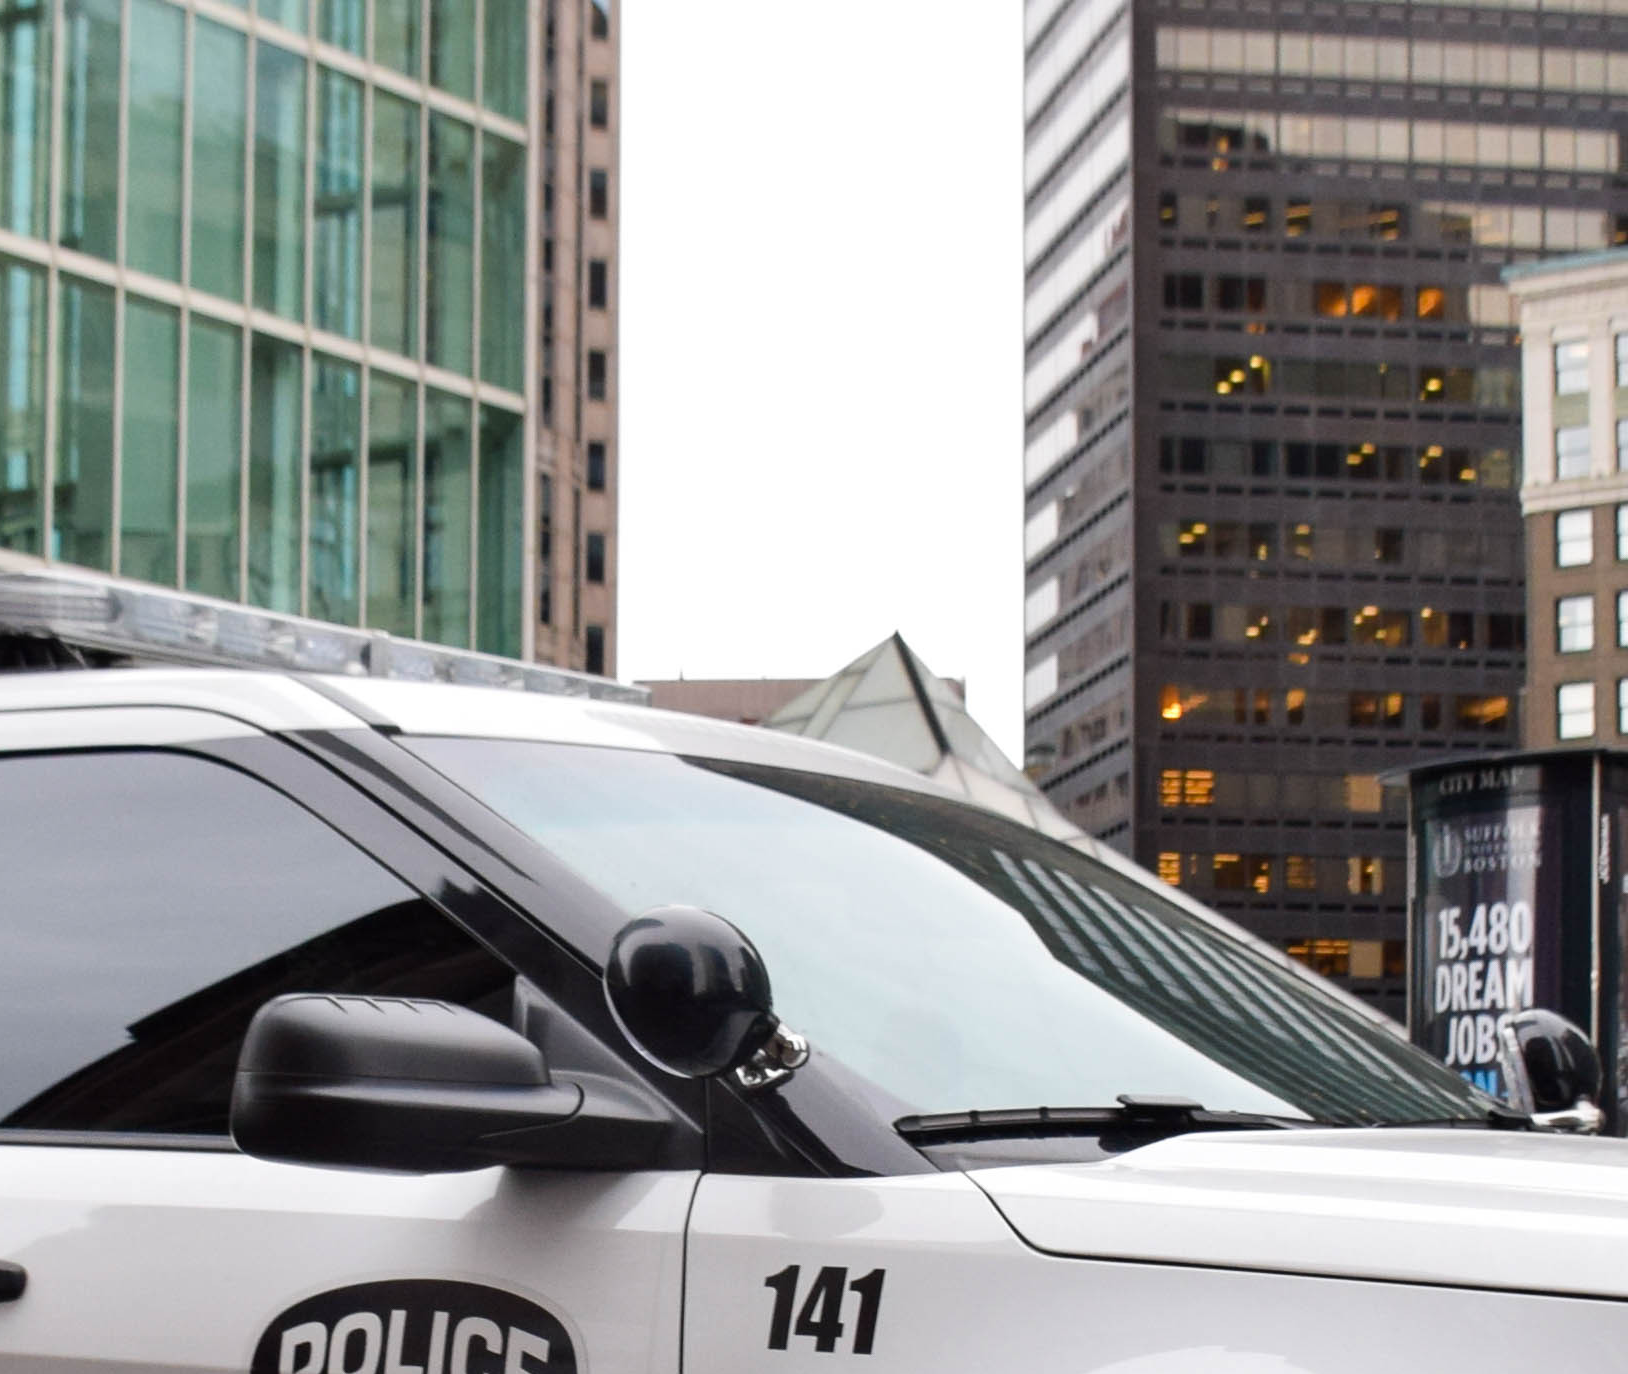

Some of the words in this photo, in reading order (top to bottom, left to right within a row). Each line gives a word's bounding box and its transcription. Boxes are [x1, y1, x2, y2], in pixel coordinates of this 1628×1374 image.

[1439, 902, 1533, 960] 15,480
[1435, 957, 1534, 1014] DREAM
[764, 1264, 886, 1355] 141
